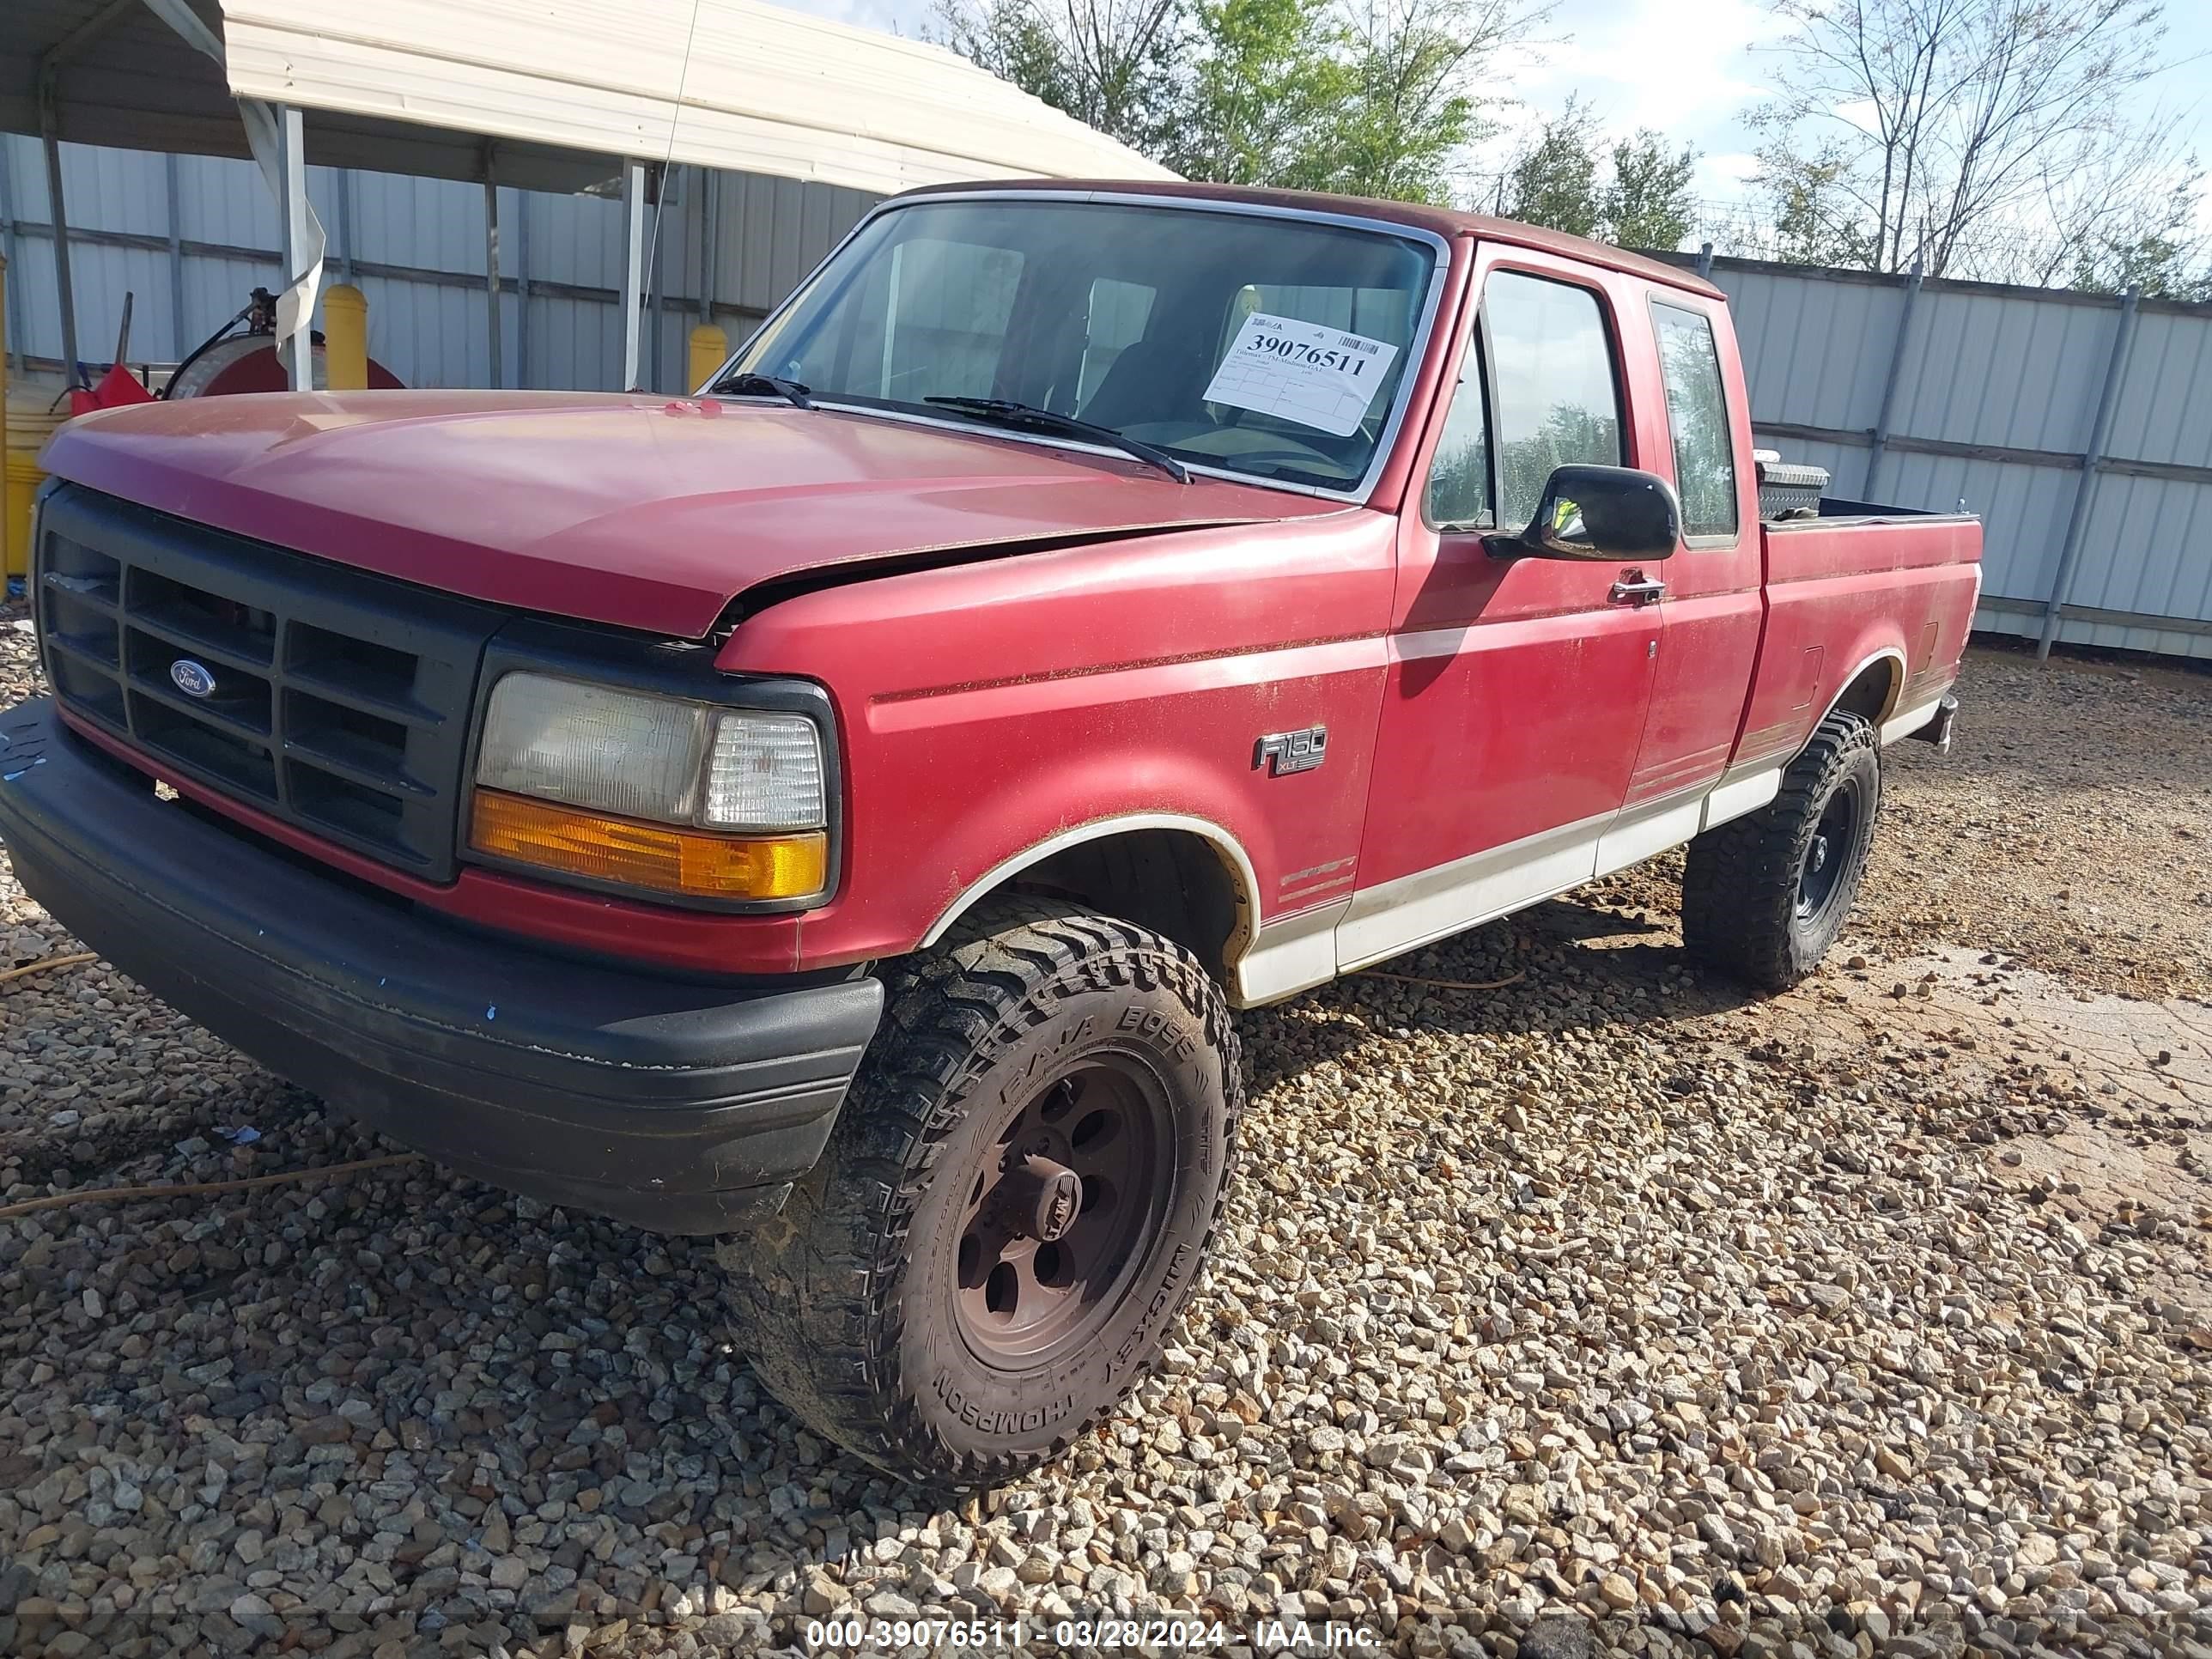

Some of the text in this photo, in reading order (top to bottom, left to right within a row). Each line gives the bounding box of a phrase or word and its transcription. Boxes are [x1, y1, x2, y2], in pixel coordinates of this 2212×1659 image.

[1247, 334, 1367, 377] 39076511
[179, 665, 202, 690] Ford
[1279, 761, 1297, 771] XLT
[1105, 1243, 1193, 1384] MICKEY
[932, 1365, 1078, 1435] THOMPSON
